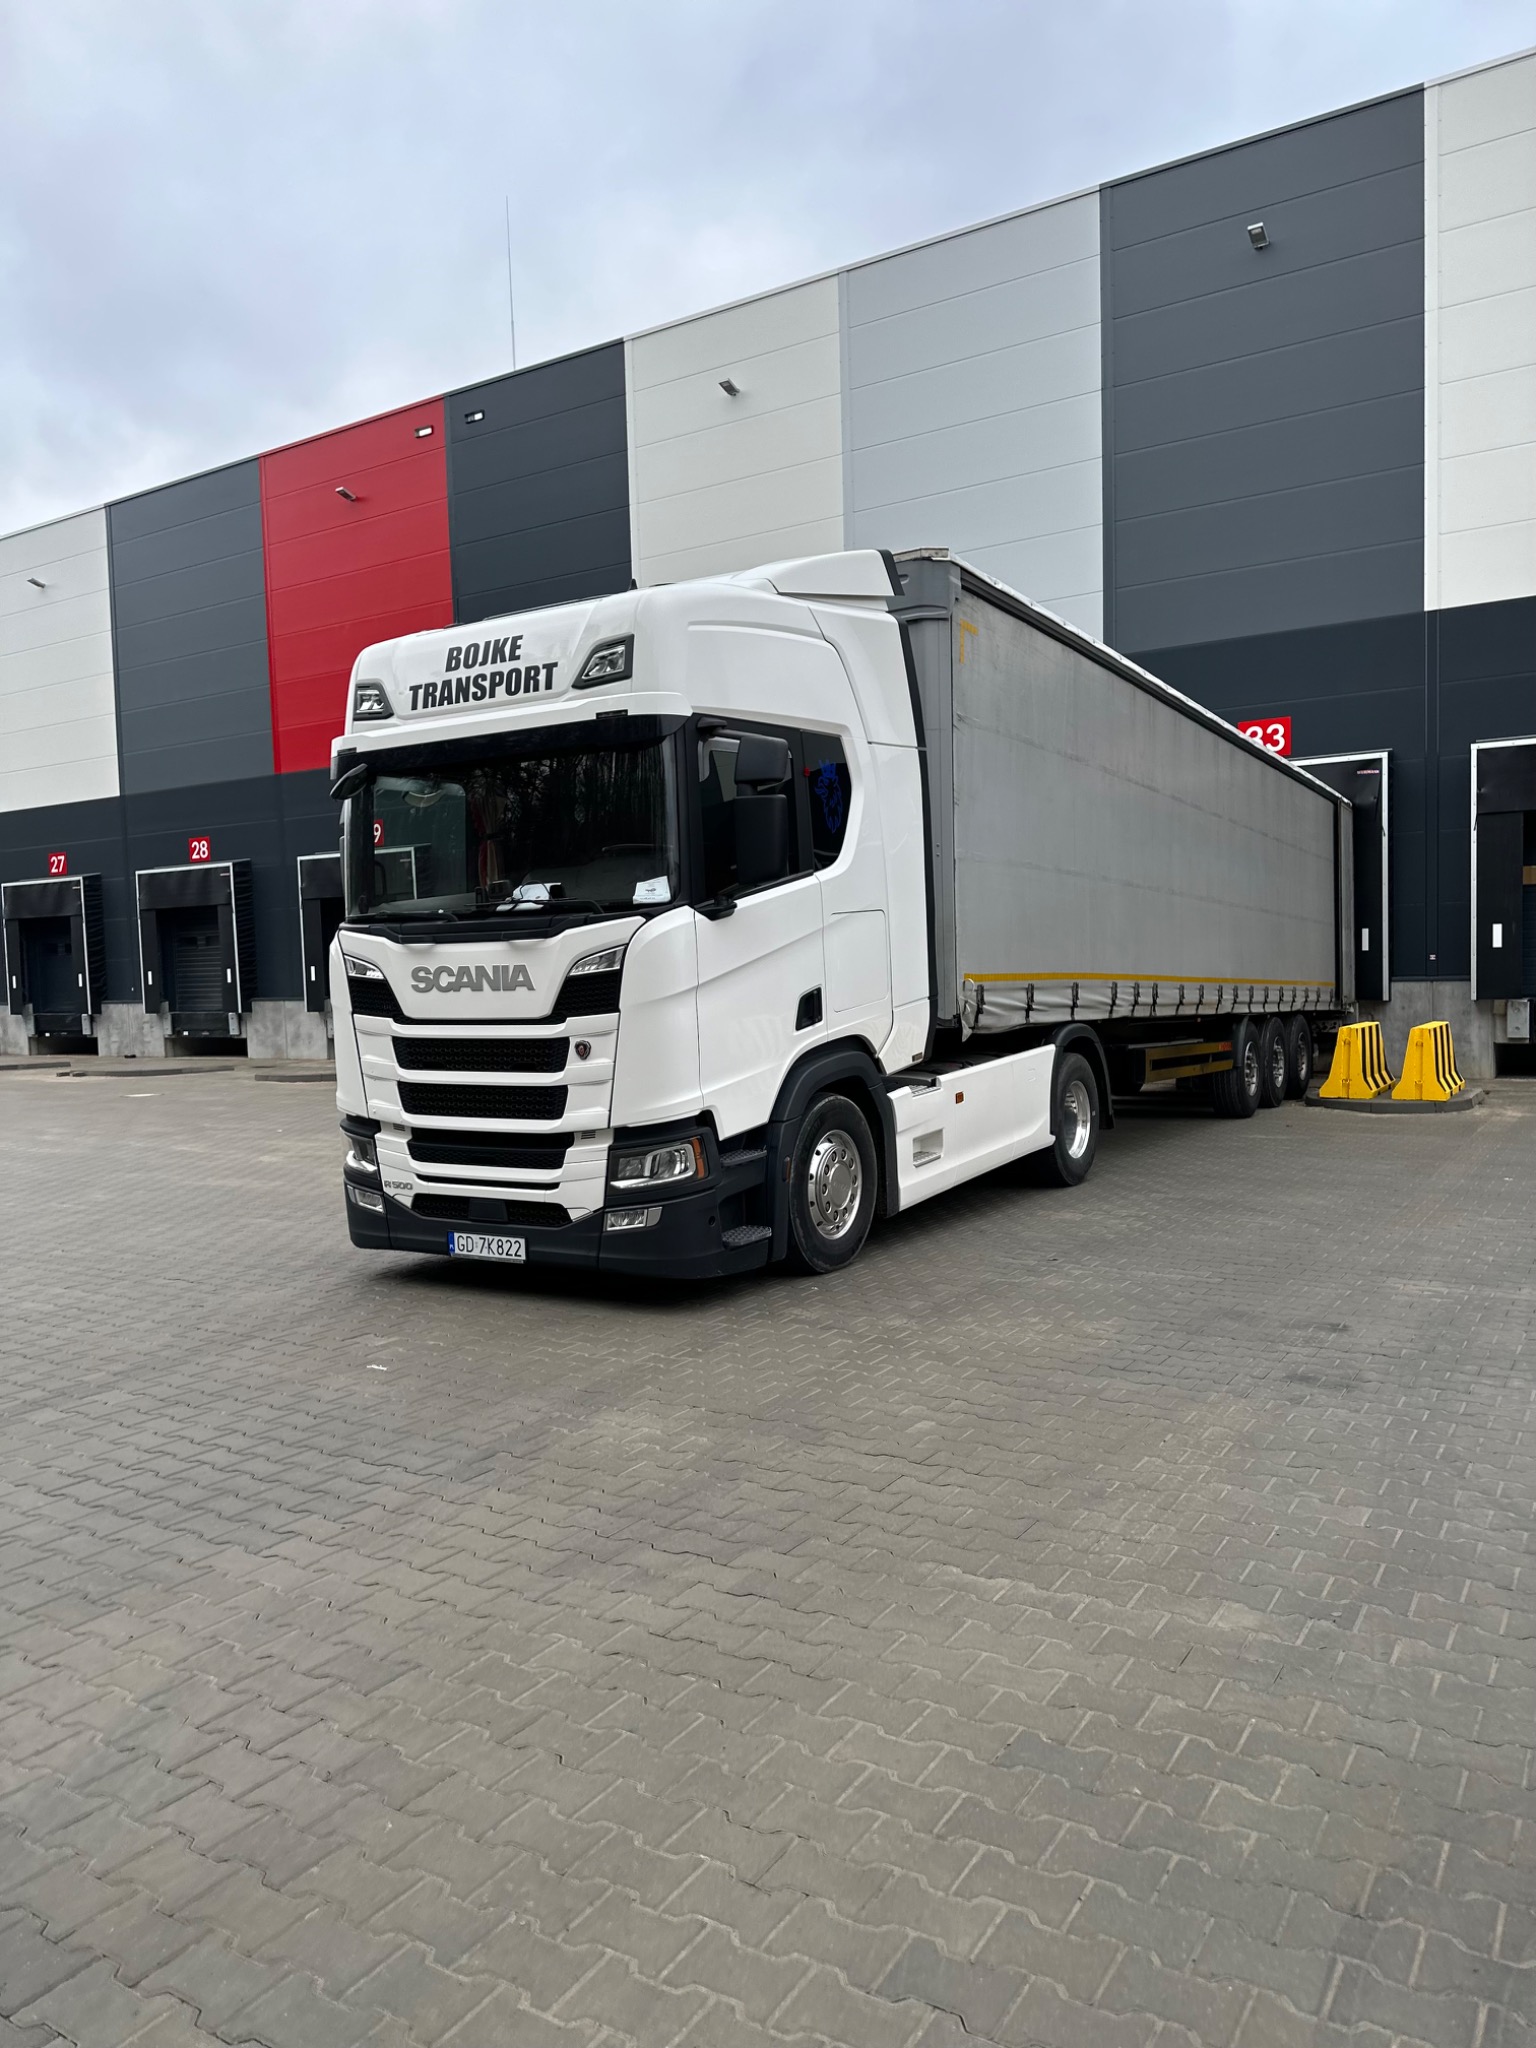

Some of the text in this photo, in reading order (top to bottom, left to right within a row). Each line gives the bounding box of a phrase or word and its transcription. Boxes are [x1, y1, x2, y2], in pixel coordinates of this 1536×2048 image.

[445, 634, 524, 673] BOJKE
[408, 661, 559, 711] TRANSPORT
[373, 823, 382, 843] 9
[191, 840, 209, 860] 28
[50, 855, 65, 873] 27
[411, 964, 536, 993] SCANIA
[392, 1181, 413, 1190] 500
[457, 1235, 522, 1257] GD 7K822
